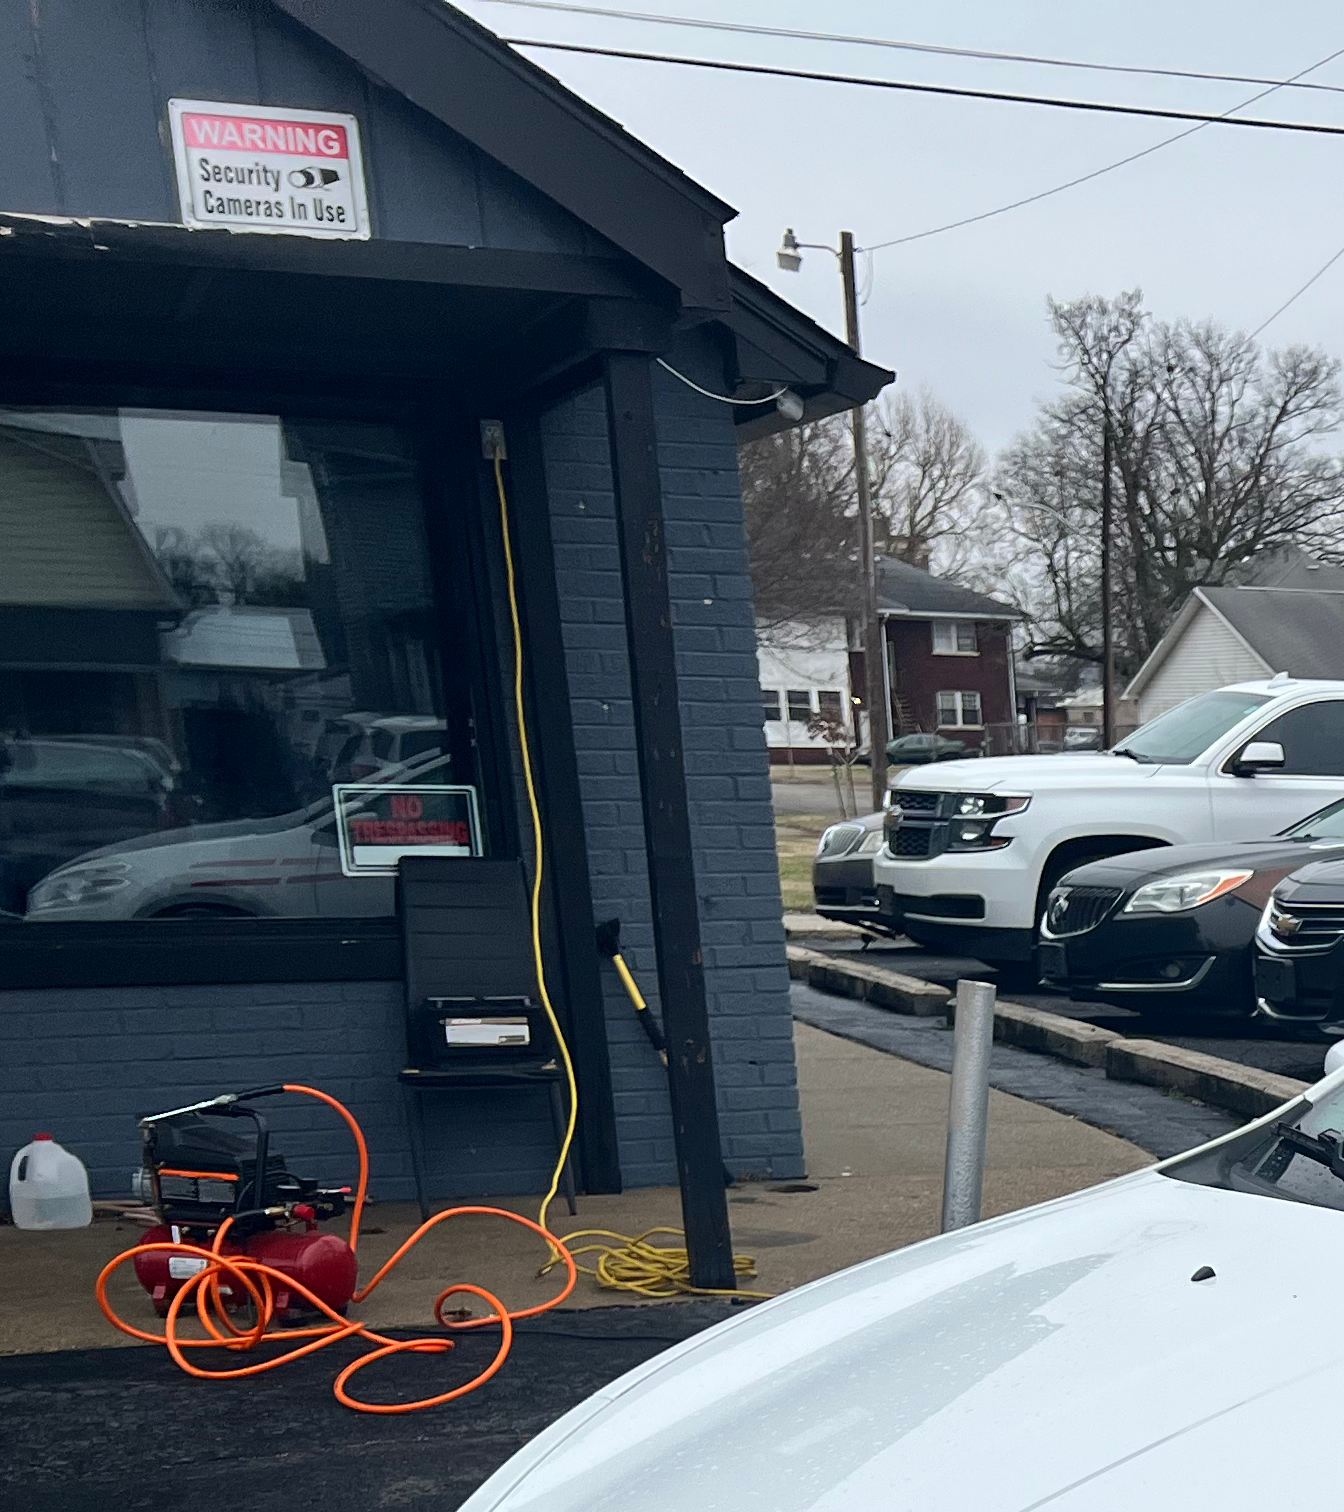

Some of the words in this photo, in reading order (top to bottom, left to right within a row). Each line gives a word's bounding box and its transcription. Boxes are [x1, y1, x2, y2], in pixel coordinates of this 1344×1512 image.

[190, 118, 341, 155] WARNING
[199, 157, 281, 192] Security
[203, 189, 284, 218] Cameras
[289, 195, 308, 220] In
[312, 197, 347, 223] Use
[390, 795, 424, 820] NO
